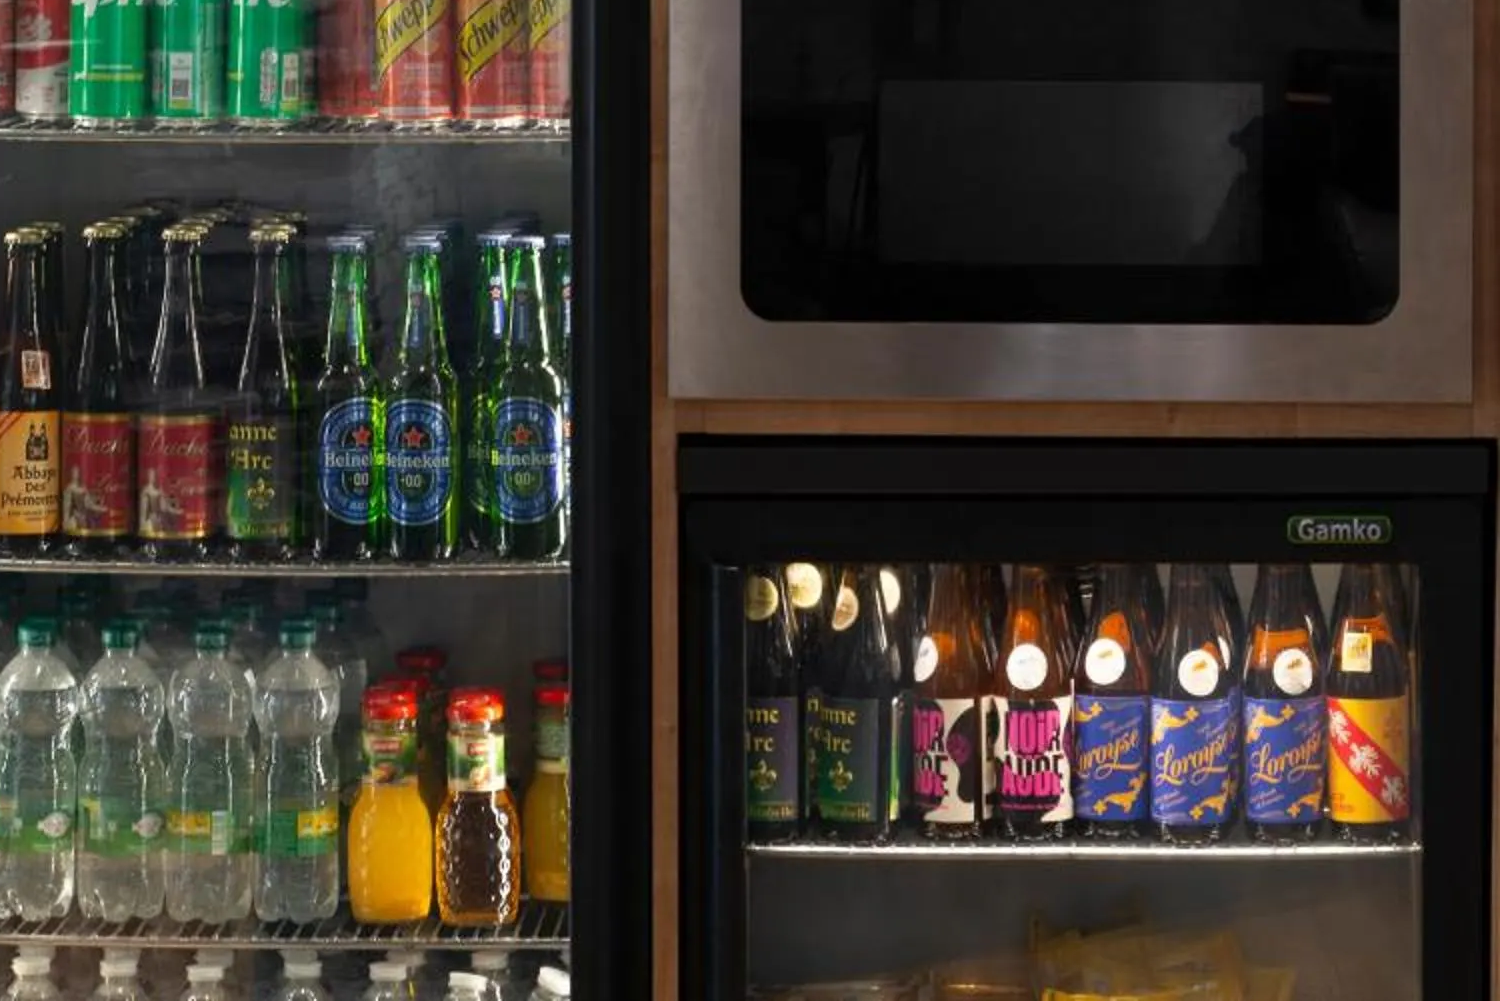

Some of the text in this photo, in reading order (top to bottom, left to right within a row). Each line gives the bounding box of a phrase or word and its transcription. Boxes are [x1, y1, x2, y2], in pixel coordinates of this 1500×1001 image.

[229, 425, 277, 440] anne
[13, 464, 56, 483] Abbay
[1298, 518, 1381, 541] Gamko
